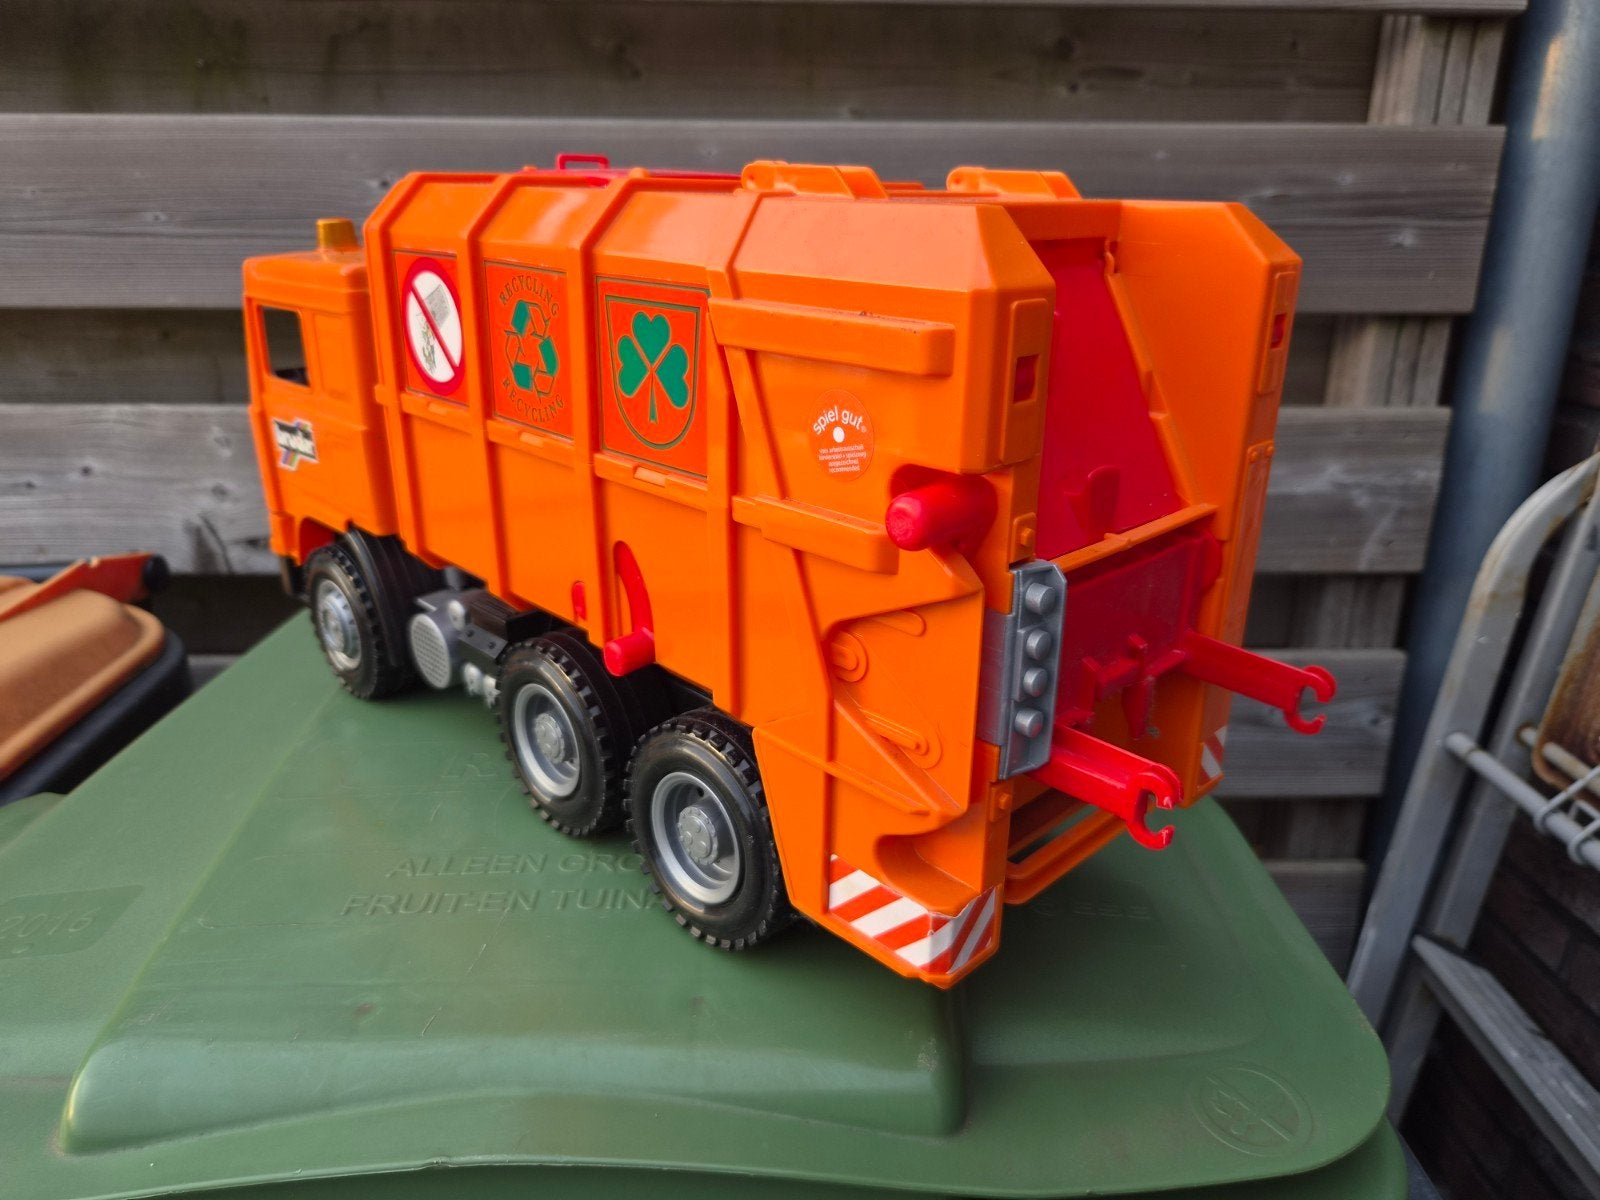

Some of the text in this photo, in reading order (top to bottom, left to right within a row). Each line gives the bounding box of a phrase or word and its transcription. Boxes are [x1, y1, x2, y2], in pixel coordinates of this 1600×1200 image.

[499, 274, 560, 321] RECYCLING
[502, 376, 564, 423] RECYCLING
[812, 404, 839, 436] spiel
[384, 852, 548, 878] ALLEEN
